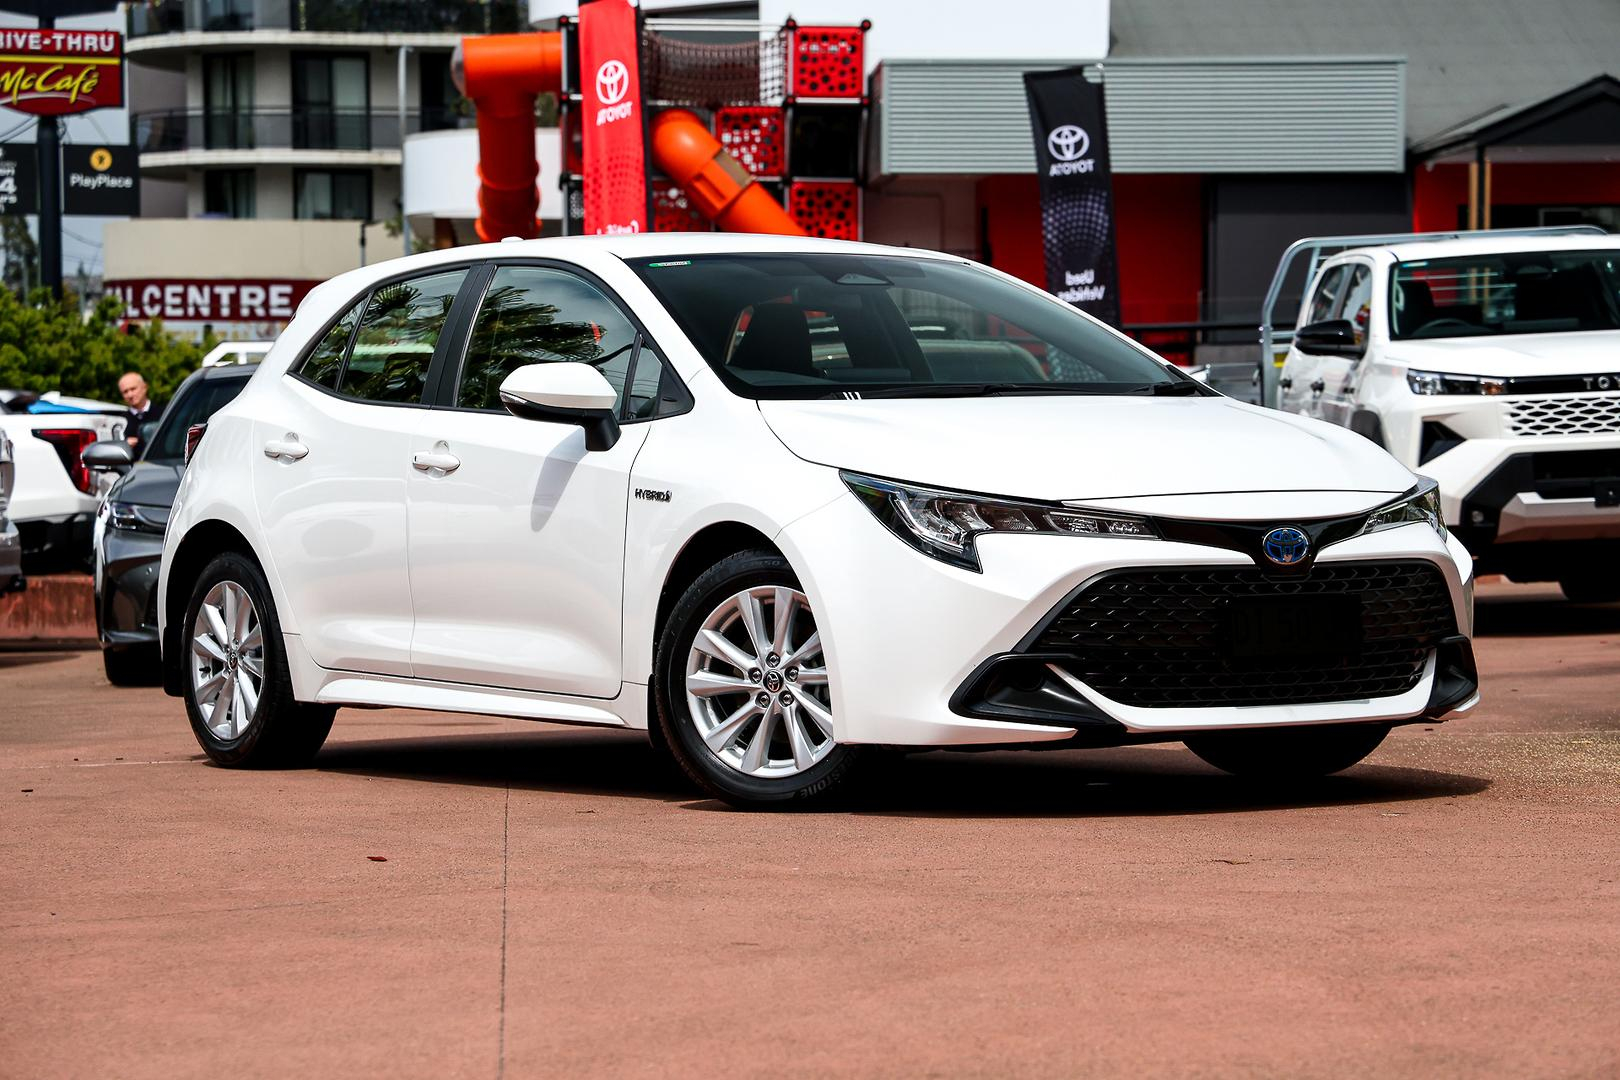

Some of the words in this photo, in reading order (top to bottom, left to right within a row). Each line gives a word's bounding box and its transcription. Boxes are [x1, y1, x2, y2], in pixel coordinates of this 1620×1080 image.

[70, 173, 133, 189] PlayPlace
[142, 284, 293, 317] CENTRE
[634, 488, 666, 502] HYBRID
